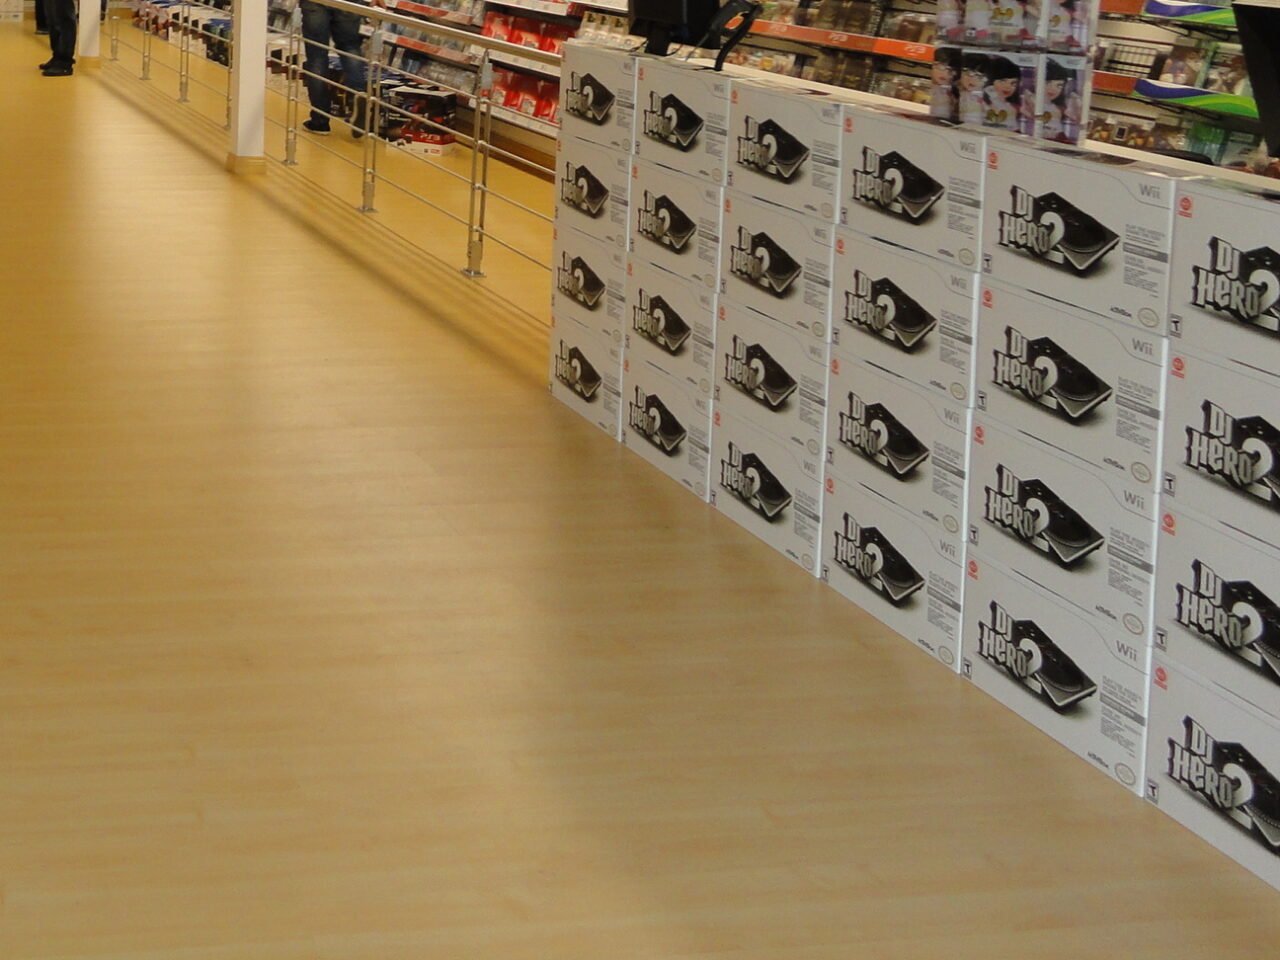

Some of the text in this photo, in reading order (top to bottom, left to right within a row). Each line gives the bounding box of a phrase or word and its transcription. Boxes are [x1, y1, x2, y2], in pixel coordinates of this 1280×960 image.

[1011, 185, 1034, 221] DJ
[1140, 183, 1159, 200] Wii
[1209, 236, 1240, 279] DJ
[1006, 326, 1028, 364] DJ
[1133, 338, 1152, 357] Wii
[1202, 401, 1232, 446] DJ
[997, 465, 1019, 504] DJ
[1123, 490, 1142, 511] Wii
[1192, 560, 1222, 608] DJ
[990, 601, 1012, 644] DJ
[1116, 641, 1134, 664] Wii
[1183, 717, 1213, 768] DJ
